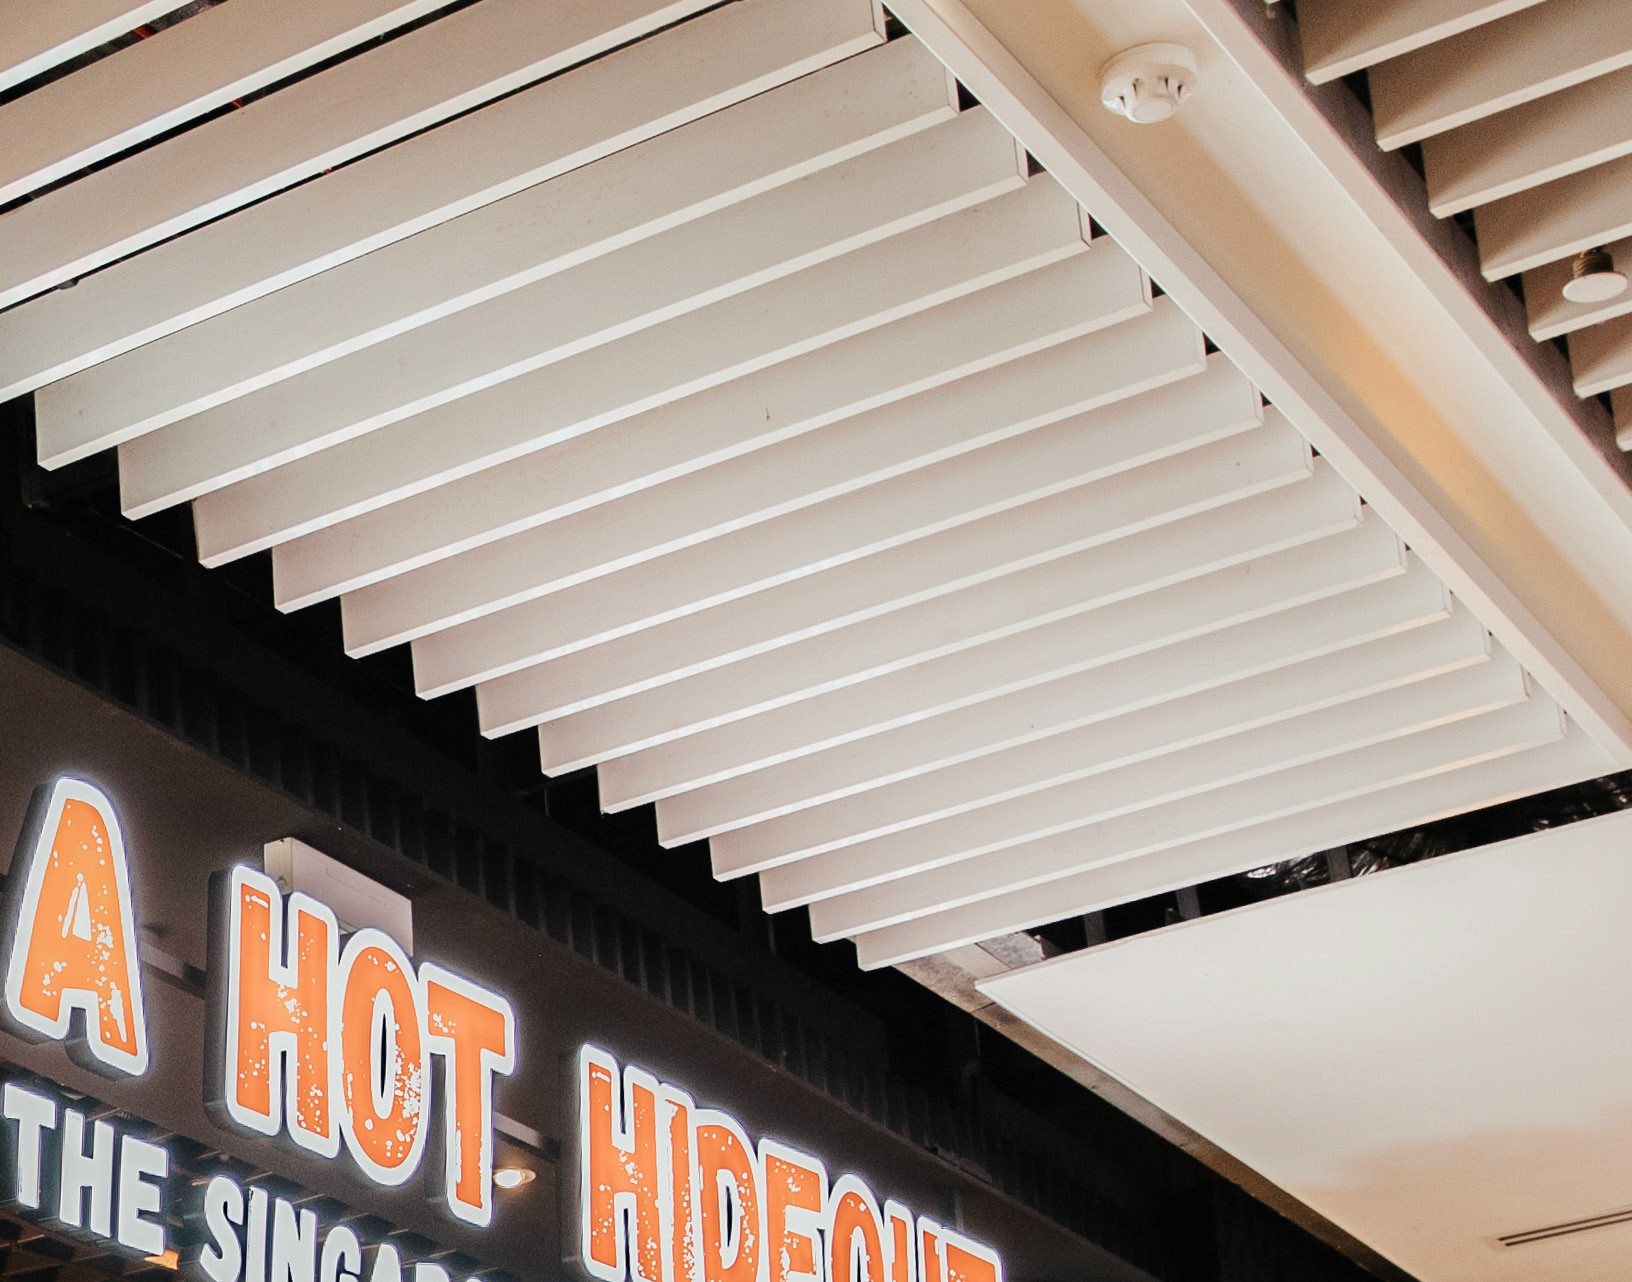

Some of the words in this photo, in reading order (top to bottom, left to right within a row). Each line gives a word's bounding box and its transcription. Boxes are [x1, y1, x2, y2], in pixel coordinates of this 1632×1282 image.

[10, 782, 144, 1070] A
[230, 868, 514, 1222] HOT
[3, 1086, 168, 1257] THE
